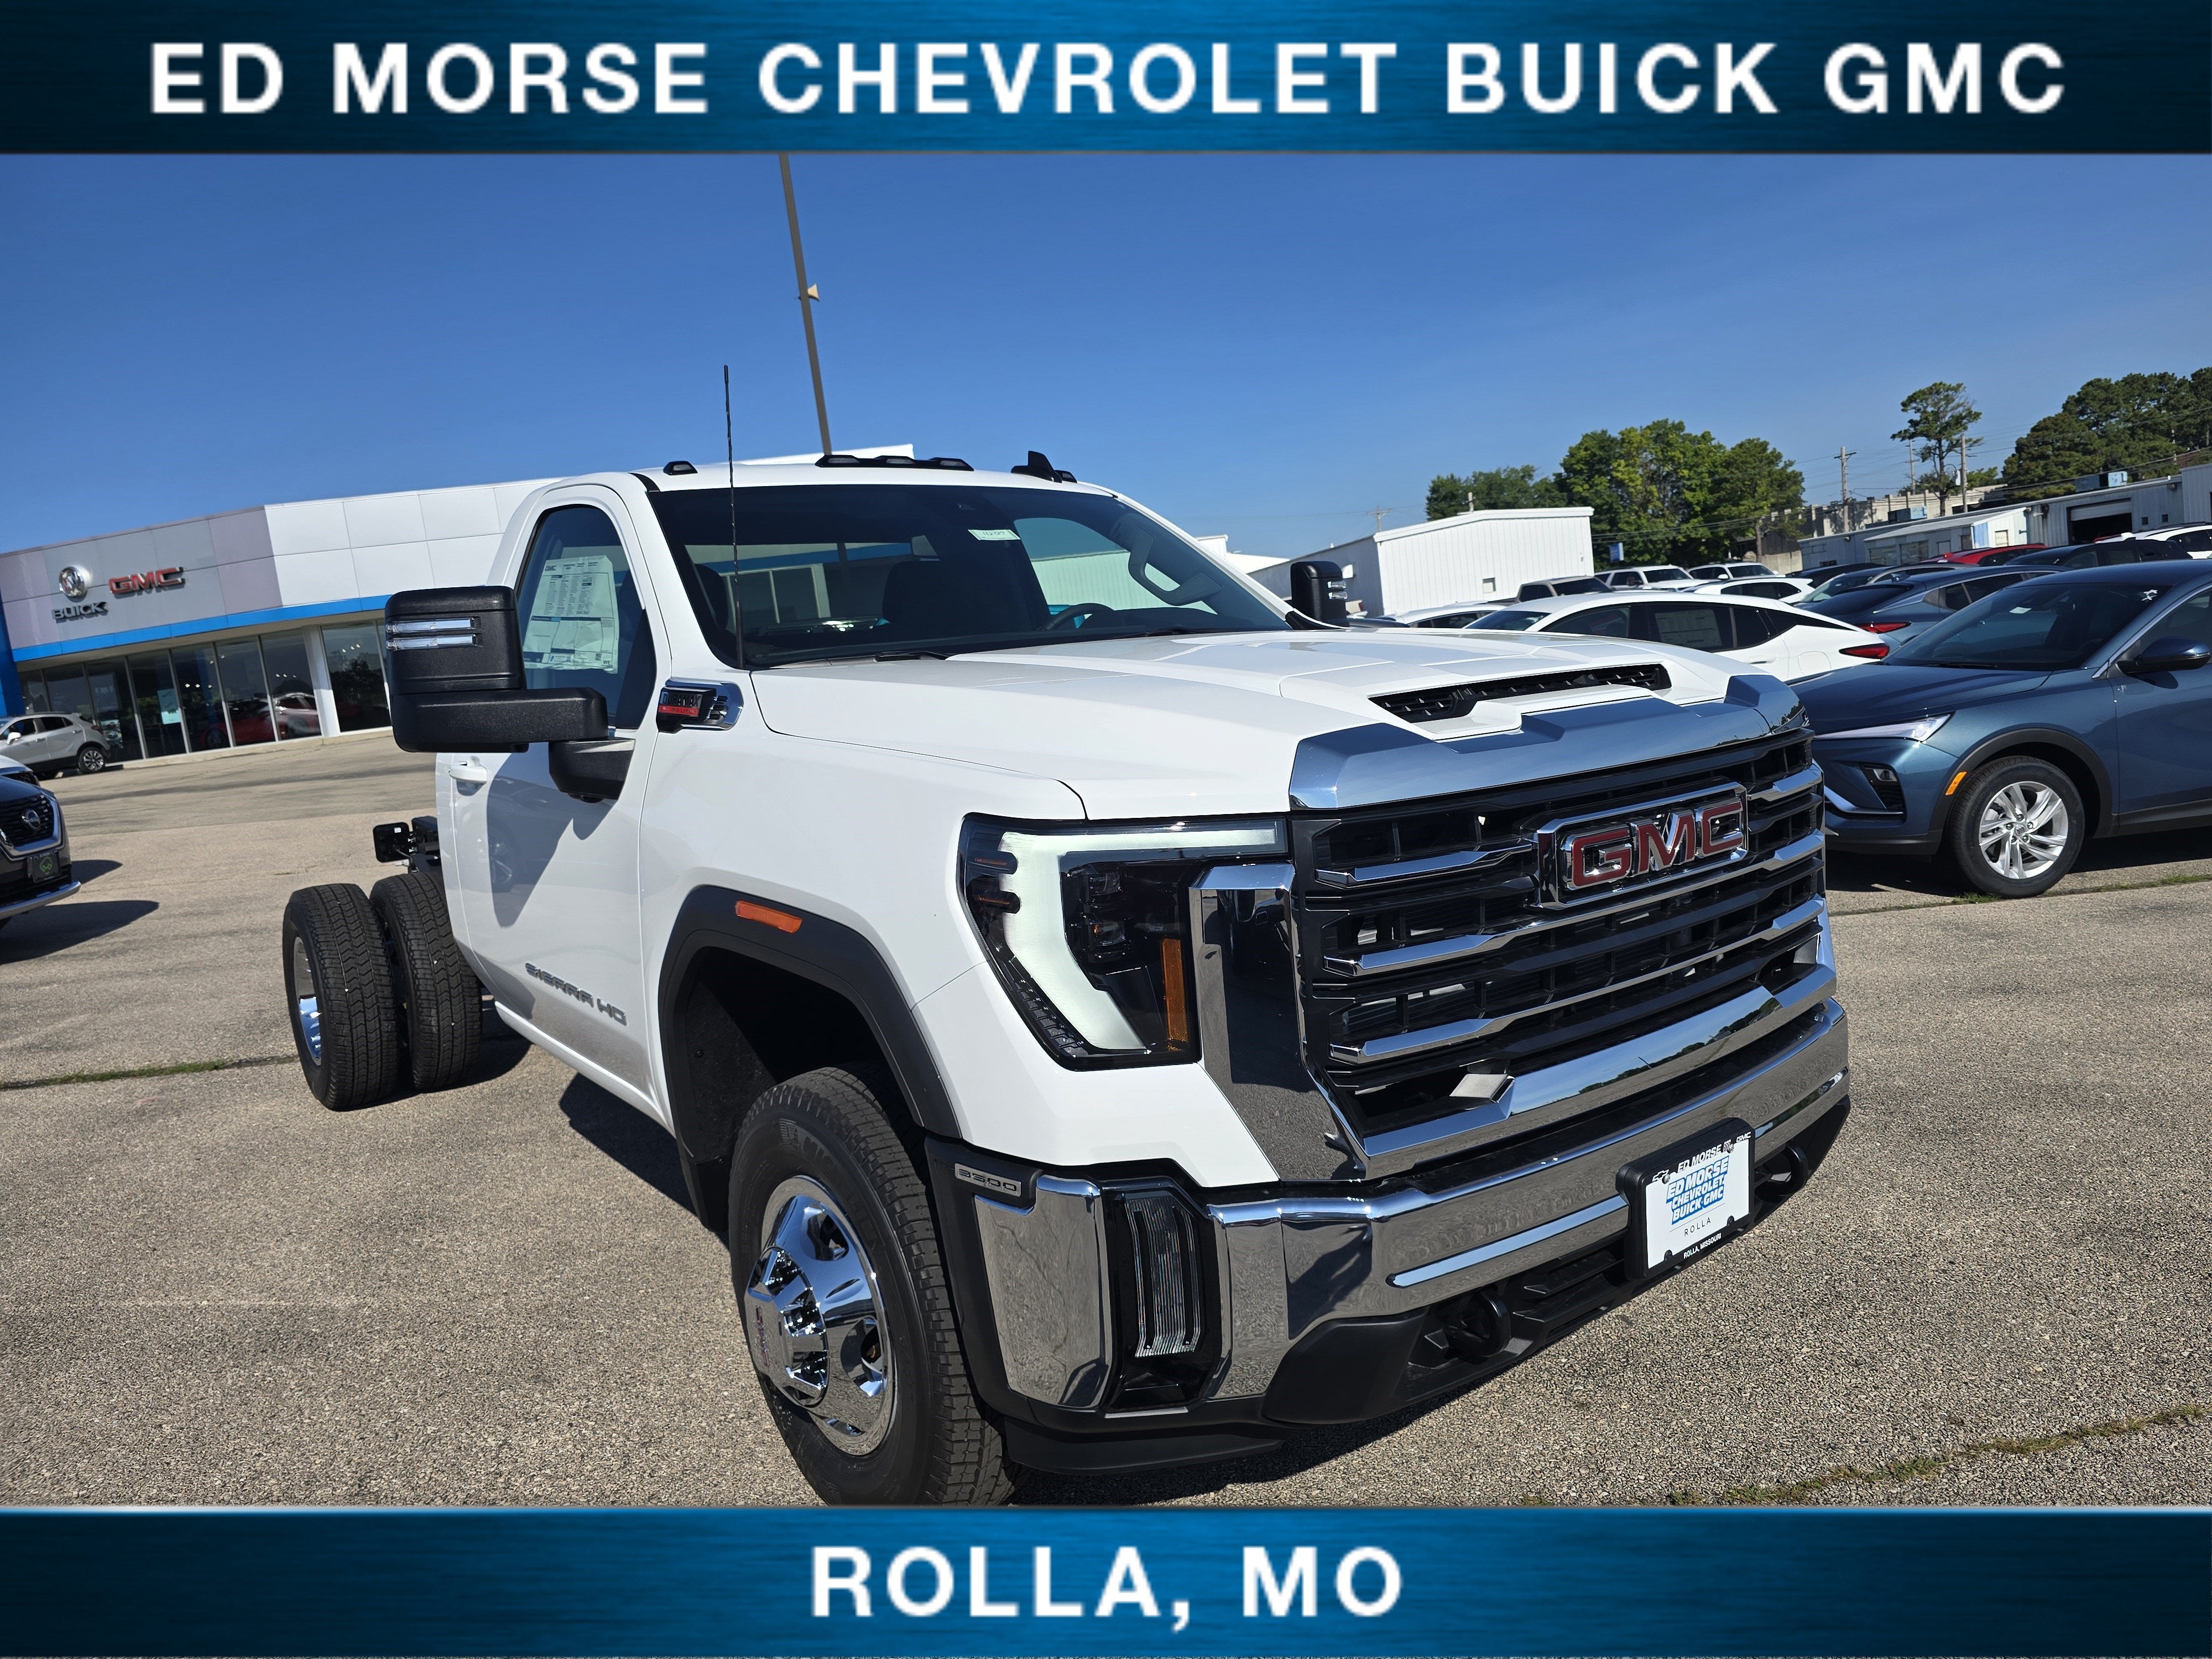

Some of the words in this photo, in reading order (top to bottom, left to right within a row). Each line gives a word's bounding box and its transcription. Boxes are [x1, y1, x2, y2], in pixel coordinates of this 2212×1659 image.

[109, 567, 183, 594] GMC
[51, 601, 108, 620] BUICK
[1564, 800, 1744, 889] GMC
[525, 962, 594, 1008] SIERRA
[596, 998, 628, 1027] HD
[1736, 1131, 1751, 1143] GMC
[1677, 1159, 1690, 1173] ED
[1691, 1144, 1722, 1167] MORSE
[958, 1168, 1018, 1192] 3500
[1667, 1178, 1686, 1202] ED
[1684, 1157, 1729, 1191] MORSE
[1671, 1174, 1725, 1210] CHEVROLET
[1672, 1196, 1703, 1223] BUICK
[1703, 1186, 1724, 1207] GMC
[1684, 1217, 1711, 1237] ROLLA
[1683, 1245, 1700, 1259] ROLLA,
[1700, 1232, 1722, 1250] MISSOURI
